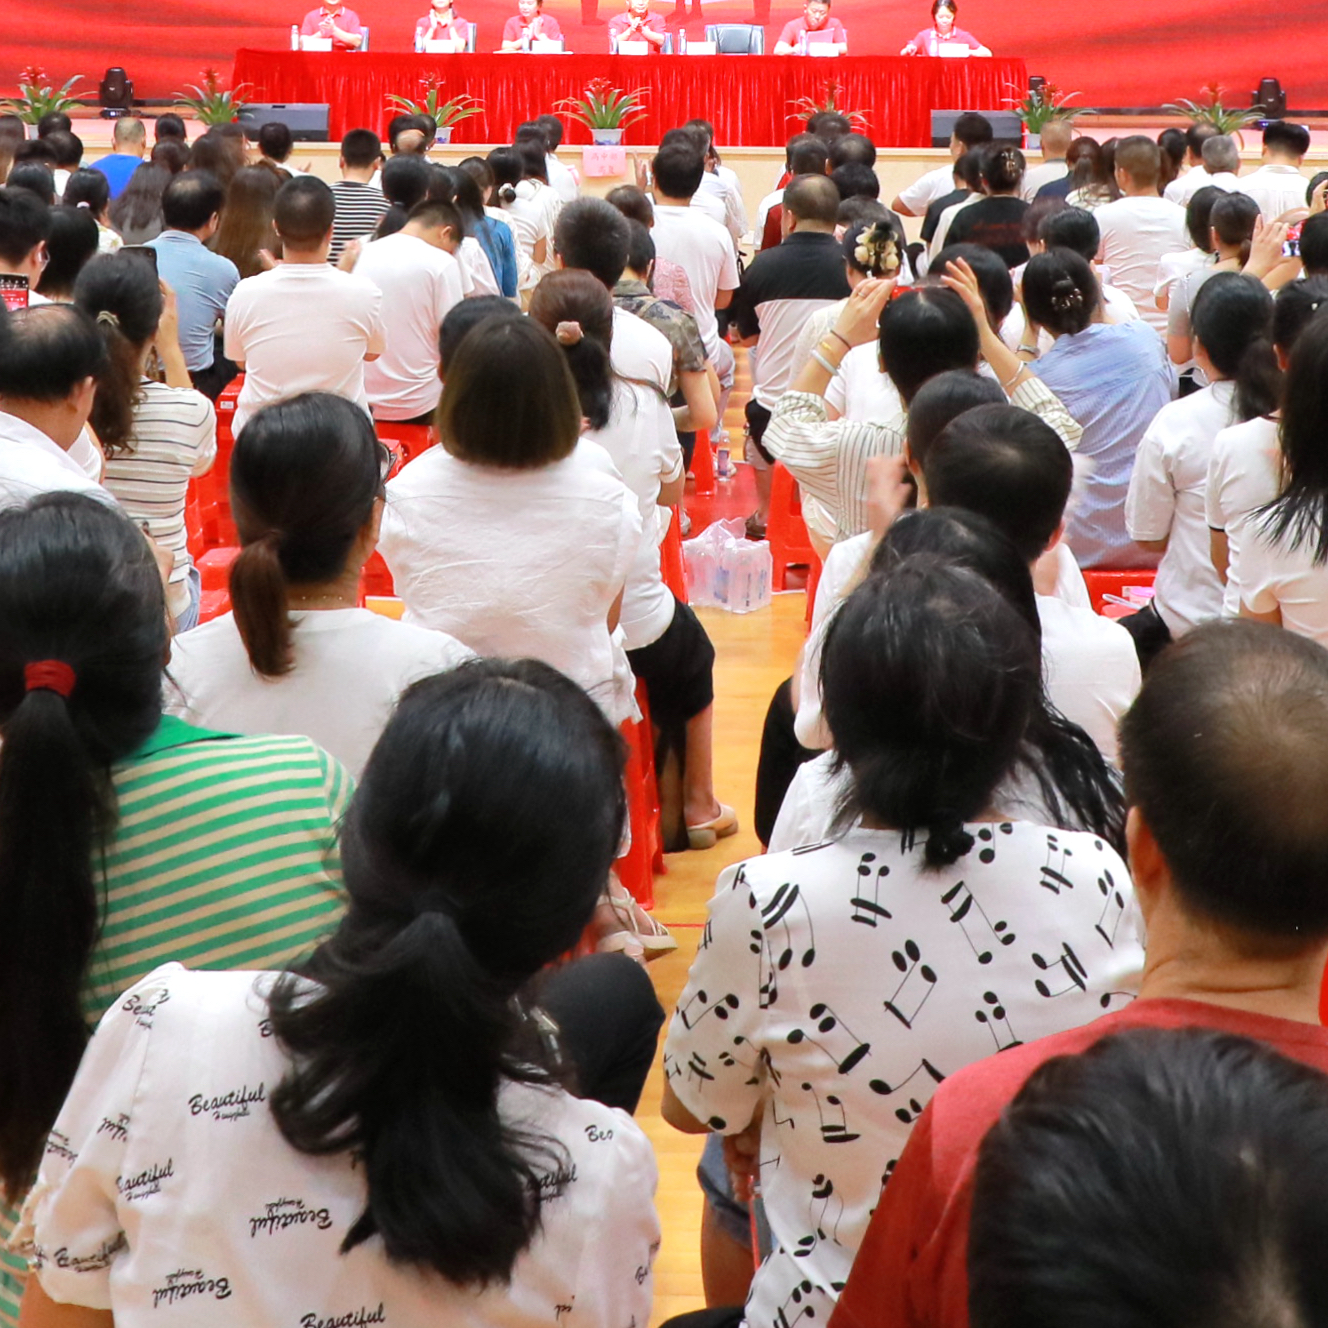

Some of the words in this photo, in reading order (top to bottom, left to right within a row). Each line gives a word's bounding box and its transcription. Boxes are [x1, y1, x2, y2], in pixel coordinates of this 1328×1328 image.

[188, 1082, 266, 1115] Beautiful
[250, 1208, 333, 1238] Beautiful
[152, 1277, 232, 1308] Beautiful
